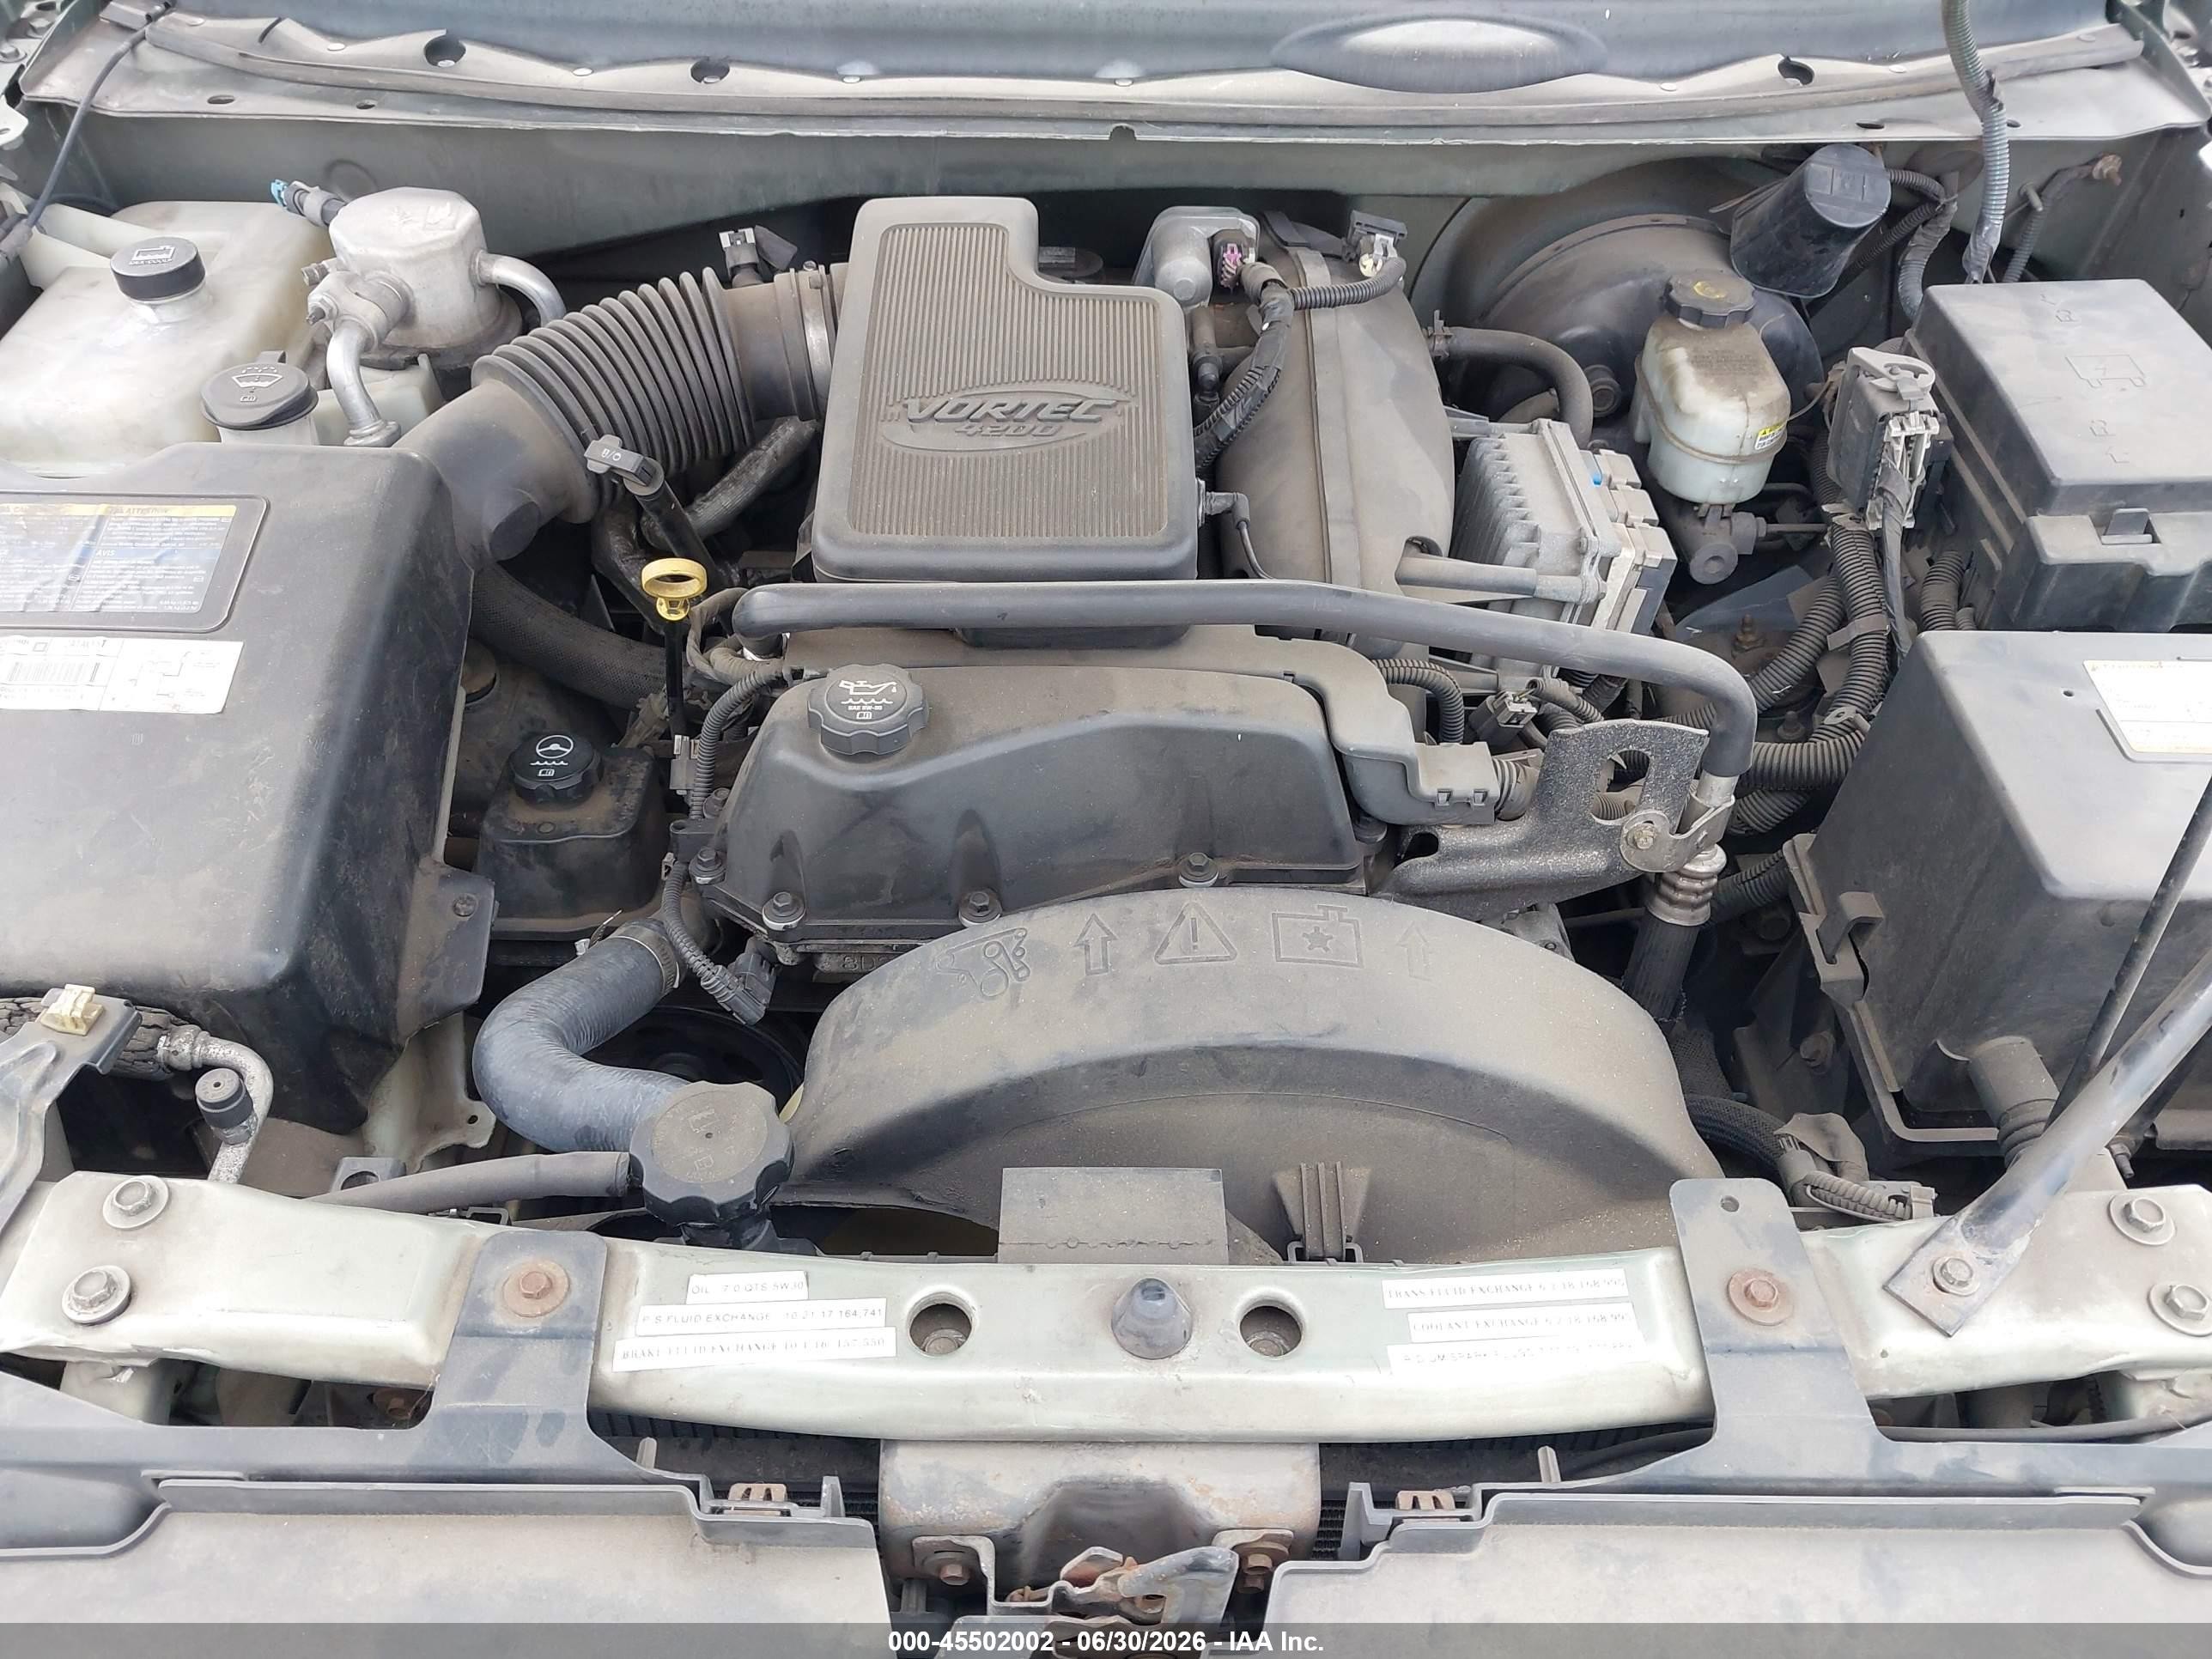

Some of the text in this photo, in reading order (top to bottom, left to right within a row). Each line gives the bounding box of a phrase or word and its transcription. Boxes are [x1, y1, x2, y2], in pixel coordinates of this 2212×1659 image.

[903, 398, 1119, 422] VORTEC
[955, 422, 1062, 437] 4200
[744, 1282, 768, 1293] QTS
[666, 1315, 702, 1324] FLUID
[706, 1312, 770, 1323] EXCHANGE
